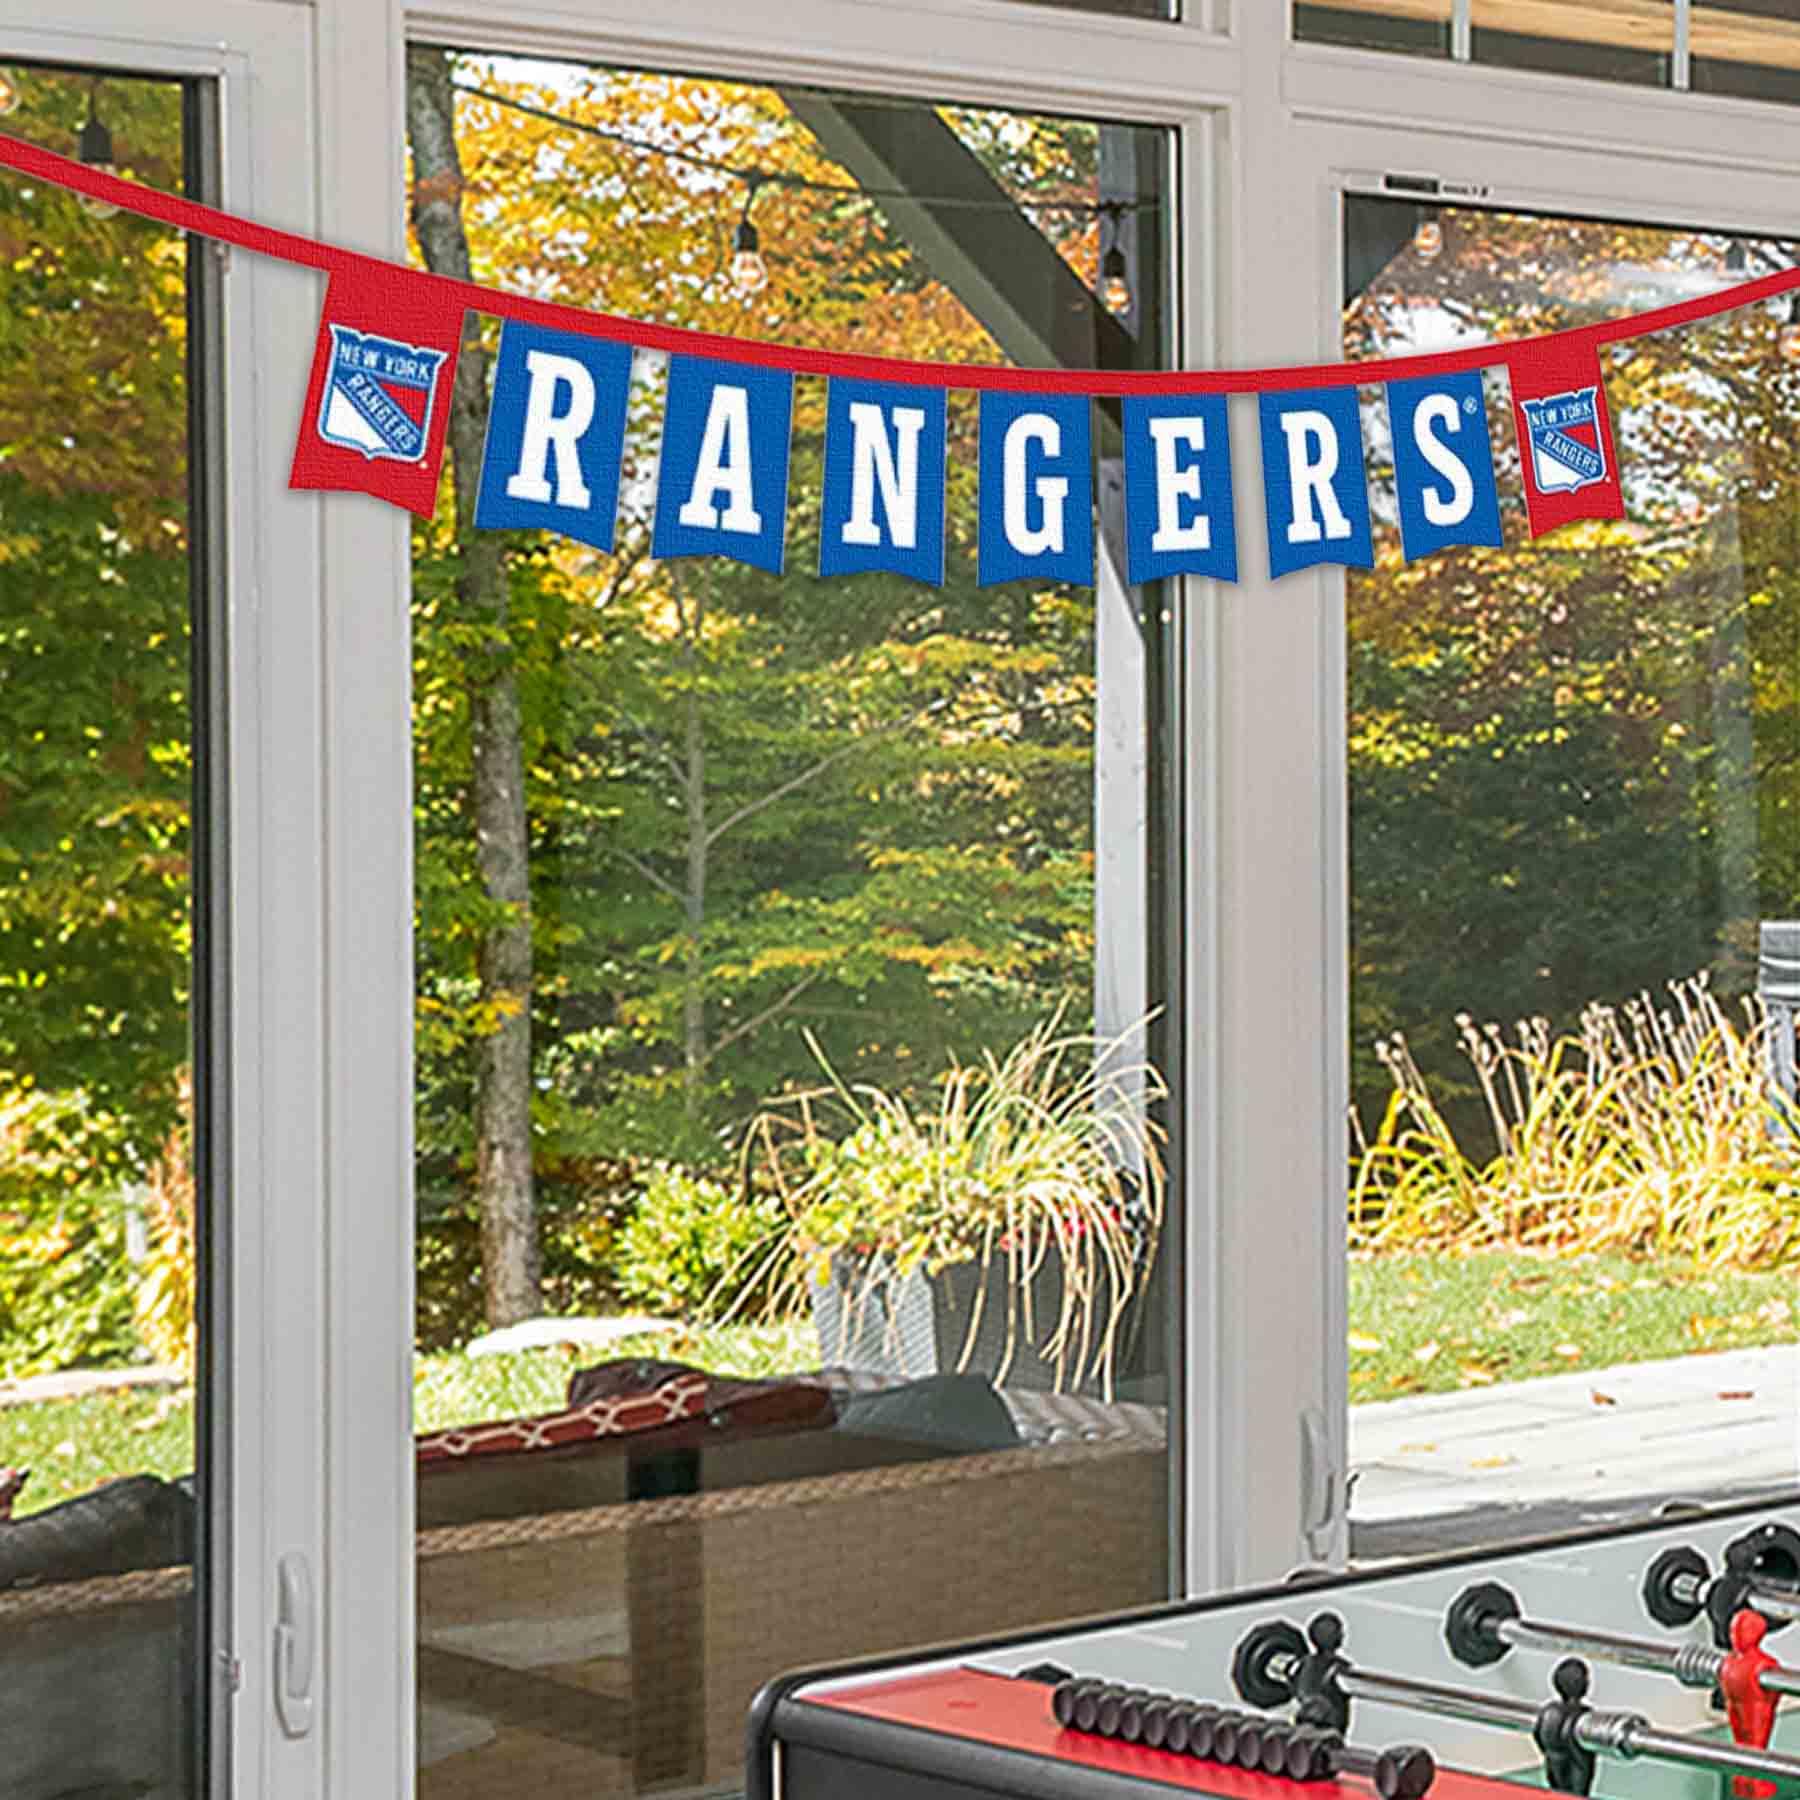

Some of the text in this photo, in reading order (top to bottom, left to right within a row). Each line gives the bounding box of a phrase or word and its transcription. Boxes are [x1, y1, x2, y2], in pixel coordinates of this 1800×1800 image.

[340, 342, 430, 381] NEW YORK
[347, 372, 418, 450] RANGERS
[1531, 400, 1592, 426] NEW YORK
[1543, 431, 1600, 477] RANGERS
